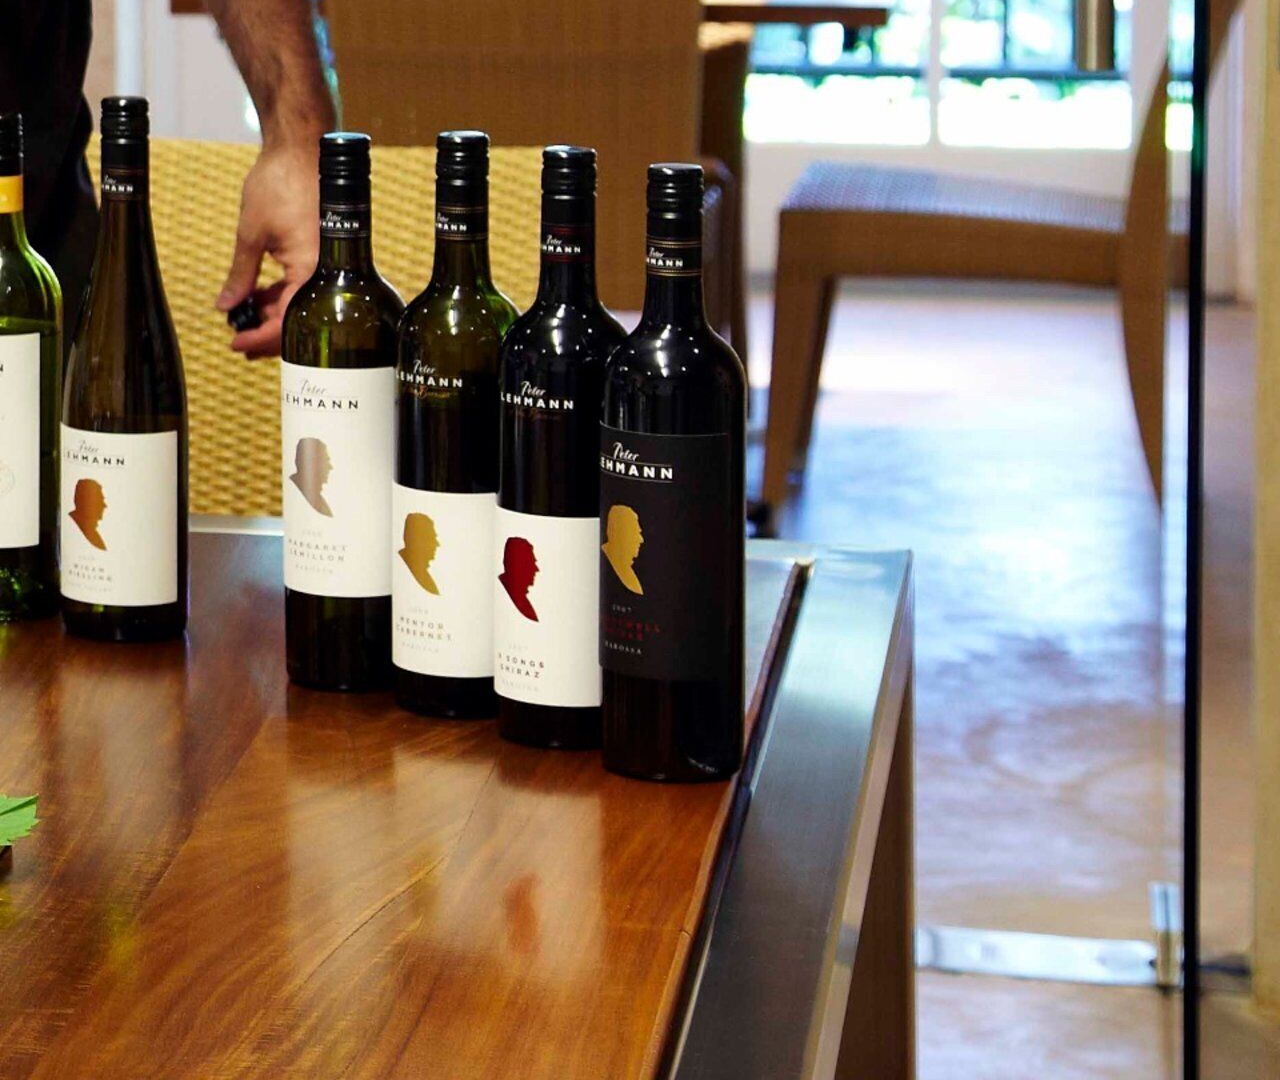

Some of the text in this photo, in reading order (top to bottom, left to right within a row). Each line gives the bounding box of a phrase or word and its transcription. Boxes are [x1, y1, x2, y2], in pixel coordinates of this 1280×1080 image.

[414, 359, 437, 374] Peter
[395, 368, 463, 388] LEHMANN
[521, 380, 546, 397] Peter
[500, 391, 574, 410] LEHMANN
[613, 441, 640, 461] Peter
[600, 456, 674, 480] EHMANN
[500, 663, 540, 679] SHIRAZ
